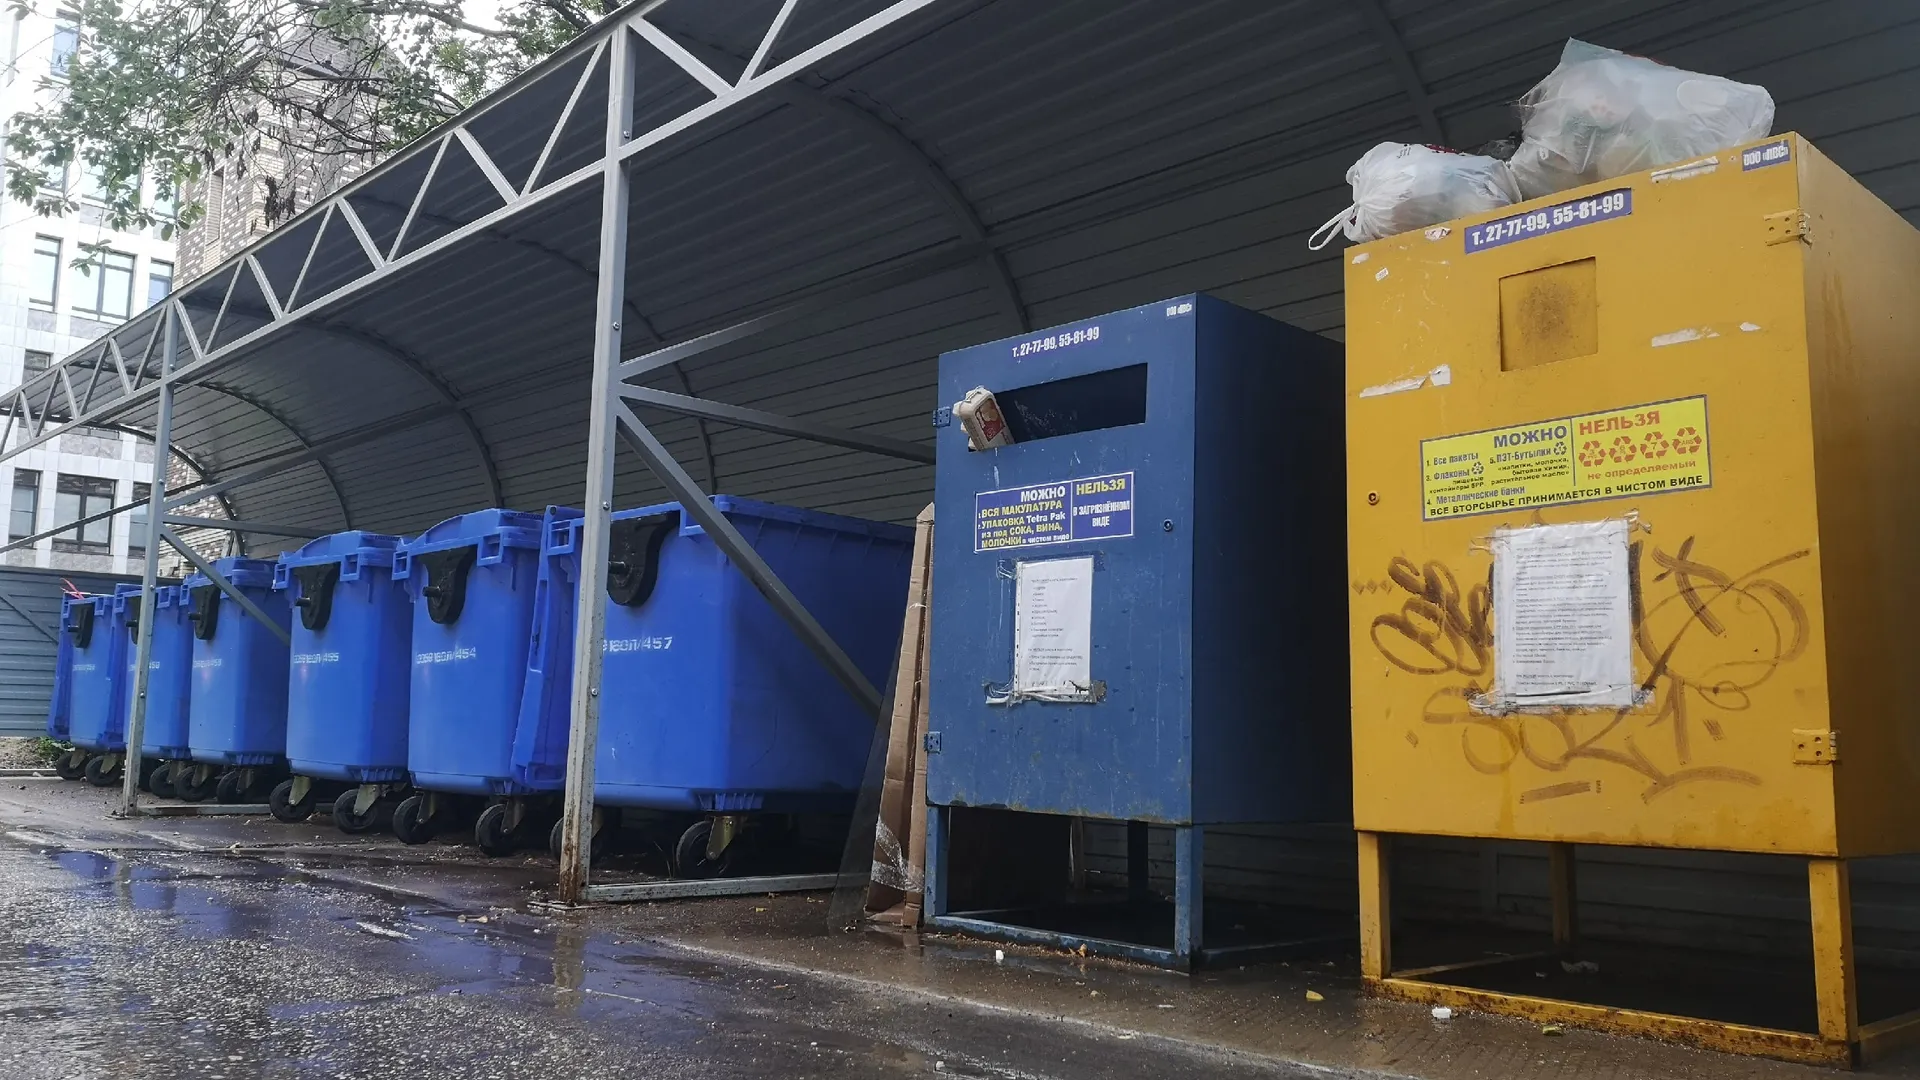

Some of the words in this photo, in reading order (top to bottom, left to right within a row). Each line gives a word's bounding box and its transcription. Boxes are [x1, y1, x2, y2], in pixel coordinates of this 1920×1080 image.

[1486, 212, 1550, 243] 27-77-99,
[1553, 192, 1624, 226] 55-81-99
[1020, 336, 1057, 356] 27-77-99,
[1059, 326, 1100, 347] 55-81-99
[1579, 410, 1660, 436] НЕЛЬЗЯ
[1493, 425, 1567, 448] МОЖНО
[1433, 456, 1447, 465] Все
[1449, 453, 1479, 464] пакеты
[1433, 469, 1470, 480] Флаконы
[1587, 471, 1601, 480] не
[1605, 460, 1696, 478] определяемый
[1020, 486, 1065, 502] МОЖНО
[1076, 478, 1125, 495] НЕЛЬЗЯ
[1430, 506, 1449, 515] ВСЕ
[1452, 497, 1515, 513] ВТОРСЫРЬЕ
[1518, 488, 1601, 505] ПРИНИМАЕТСЯ
[1616, 480, 1666, 493] ЧИСТОМ
[1670, 475, 1703, 487] ВИДЕ
[1436, 490, 1499, 504] Металлические
[1501, 485, 1525, 496] банки
[981, 507, 999, 518] ВСЯ
[1001, 500, 1062, 515] МАКУЛАТУРА
[981, 517, 1025, 529] УПАКОВКА
[1026, 515, 1048, 524] Tetra
[1050, 511, 1066, 521] Pak
[1092, 516, 1110, 527] ВИДЕ
[981, 531, 991, 539] из
[993, 529, 1008, 538] под
[1009, 525, 1034, 535] СОКА,
[1036, 522, 1063, 532] ВИНА,
[981, 536, 1022, 548] МОЛОЧКИ
[1028, 535, 1051, 544] чистом
